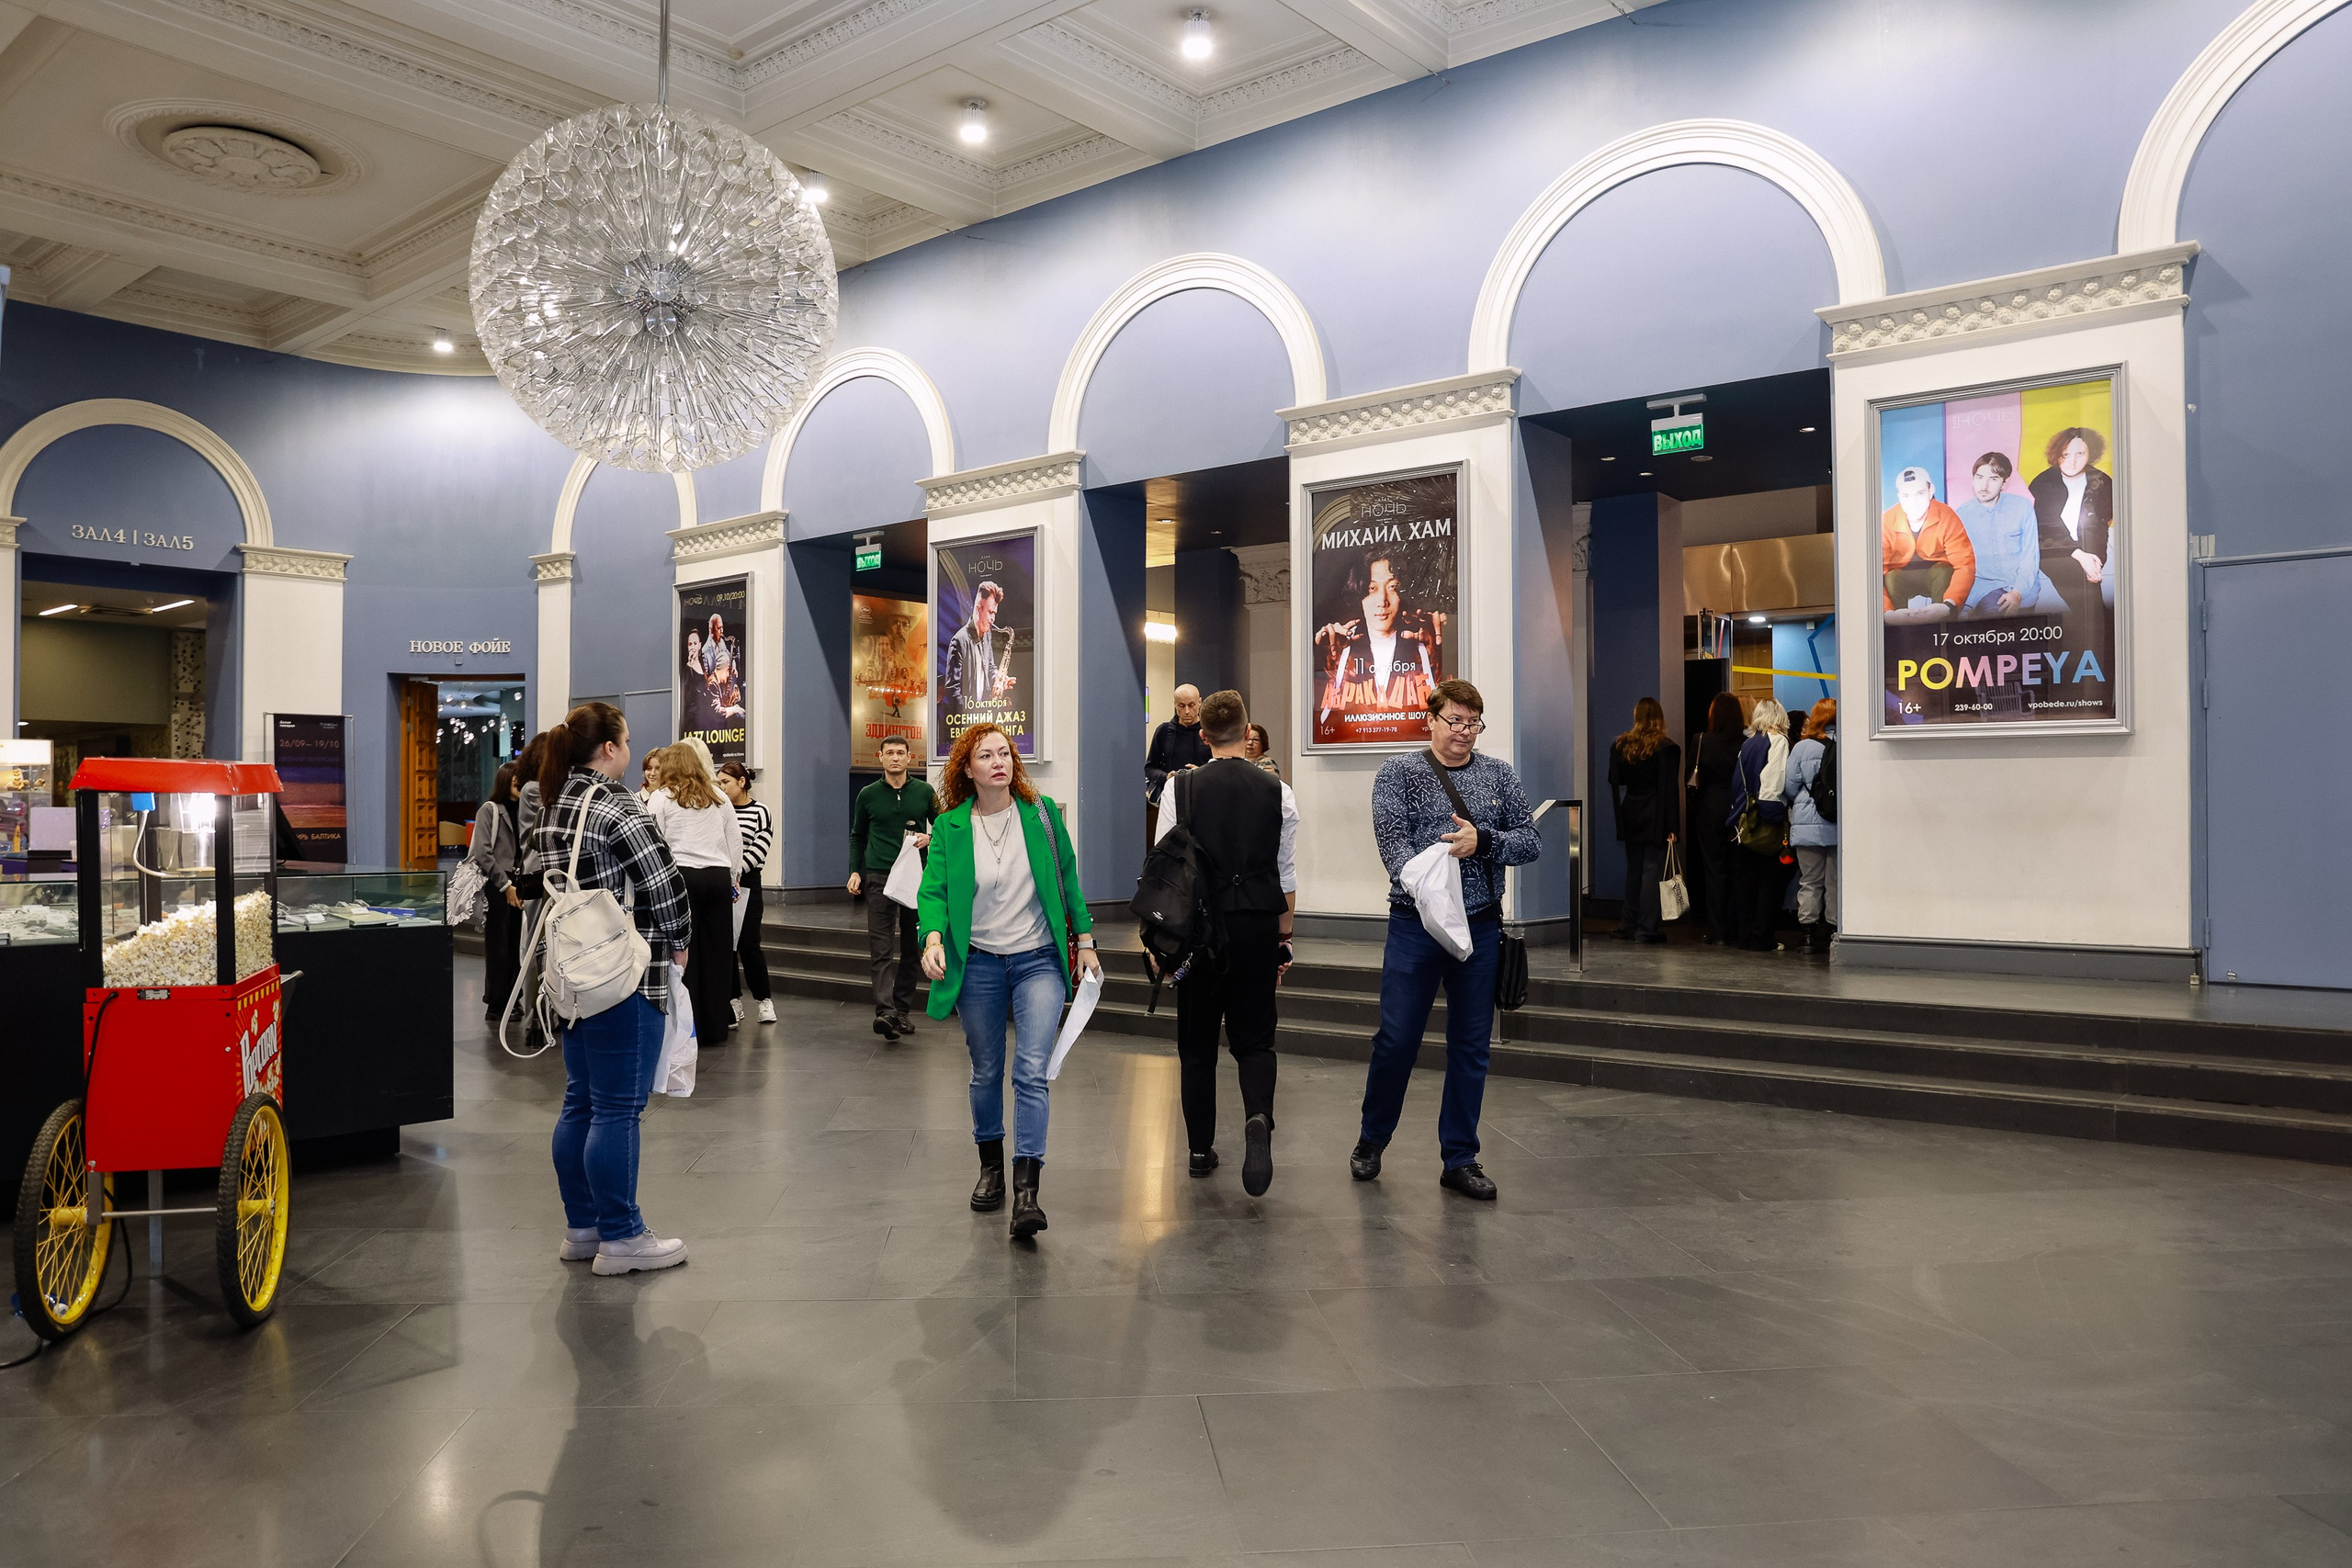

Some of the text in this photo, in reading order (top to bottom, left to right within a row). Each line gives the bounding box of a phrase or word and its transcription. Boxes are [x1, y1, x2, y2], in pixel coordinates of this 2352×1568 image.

[1654, 429, 1702, 452] ВЫХОД
[1361, 502, 1407, 517] НОЧЬ
[72, 525, 127, 544] ЗАЛ4
[143, 533, 194, 550] ЗАЛ5
[1321, 518, 1452, 550] МИХАИЛ ХАМ
[968, 559, 1003, 574] НОЧЬ
[1933, 626, 2063, 646] 17 октября 20:00
[409, 637, 511, 654] НОВОЕ ФОЙЕ
[1353, 658, 1364, 675] 11
[1897, 649, 2106, 691] POMPEYA
[964, 695, 1007, 709] 16 октября
[1898, 699, 2103, 715] 16+ 239-60-00 vpobede.ru/shows
[945, 710, 1026, 725] ОСЕННИЙ ДЖАЗ
[1344, 711, 1427, 723] ИЛЛЮЗИОННОЕ ШОУ
[707, 728, 745, 743] LOUNGE
[865, 723, 923, 739] ЭДДИНГТОН
[1320, 726, 1336, 735] 16+
[315, 739, 340, 750] 19/10
[240, 1021, 278, 1099] POPCORN
